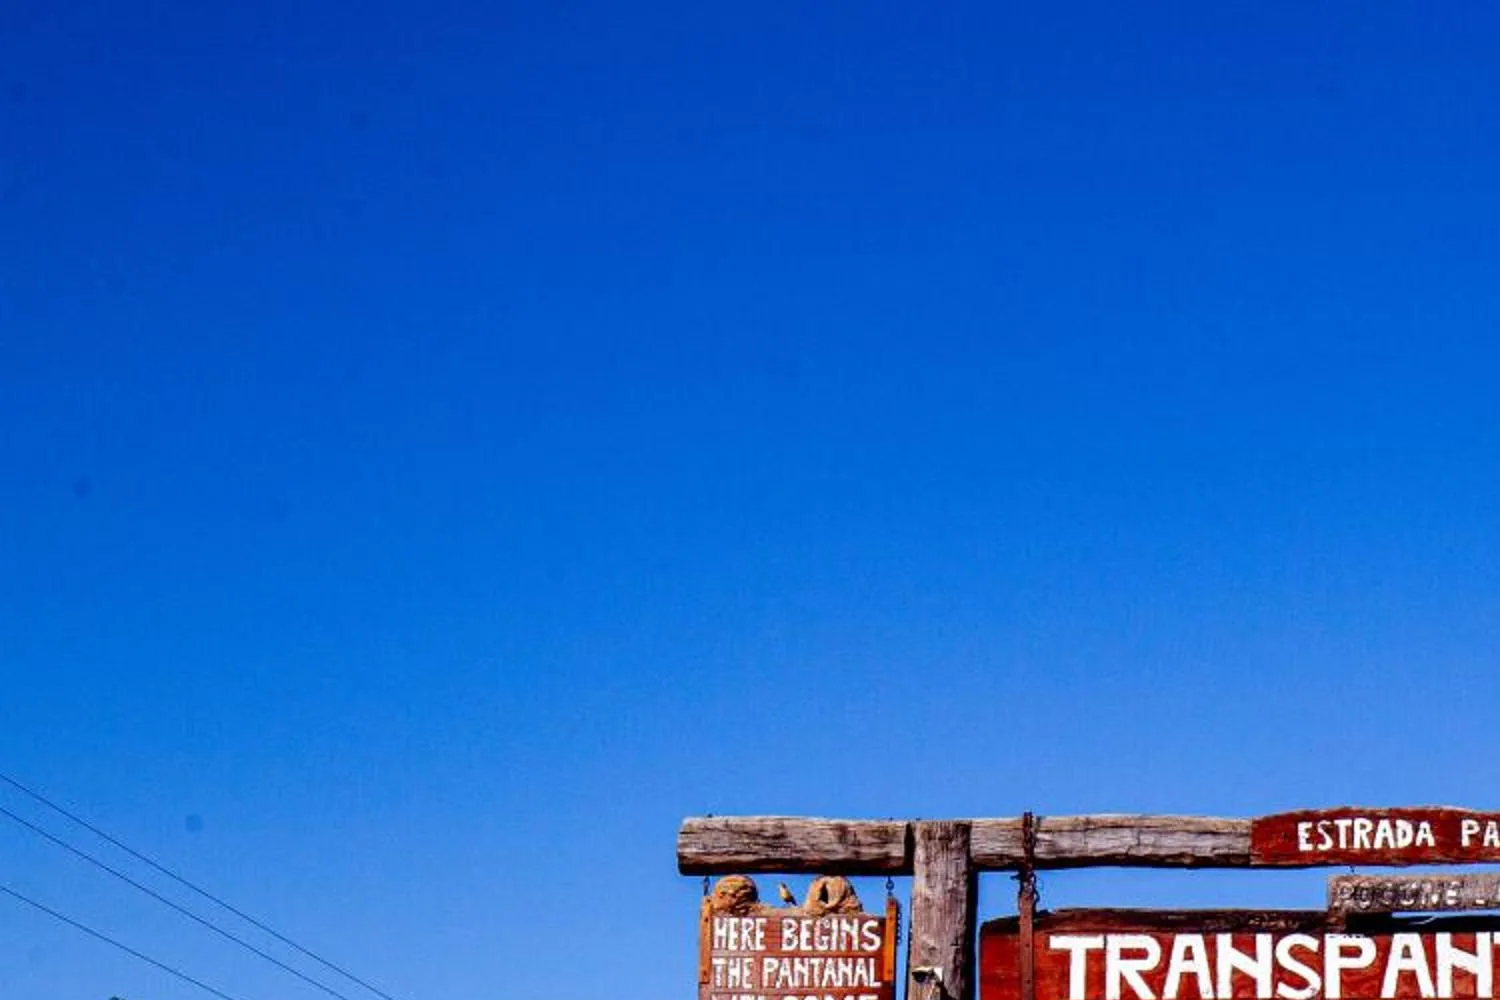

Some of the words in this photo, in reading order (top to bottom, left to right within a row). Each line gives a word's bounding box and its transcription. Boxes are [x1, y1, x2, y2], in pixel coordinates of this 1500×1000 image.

[1298, 817, 1436, 851] ESTRADA
[713, 917, 767, 950] HERE
[782, 917, 882, 951] BEGINS
[712, 957, 753, 989] THE
[762, 956, 882, 988] PANTANAL
